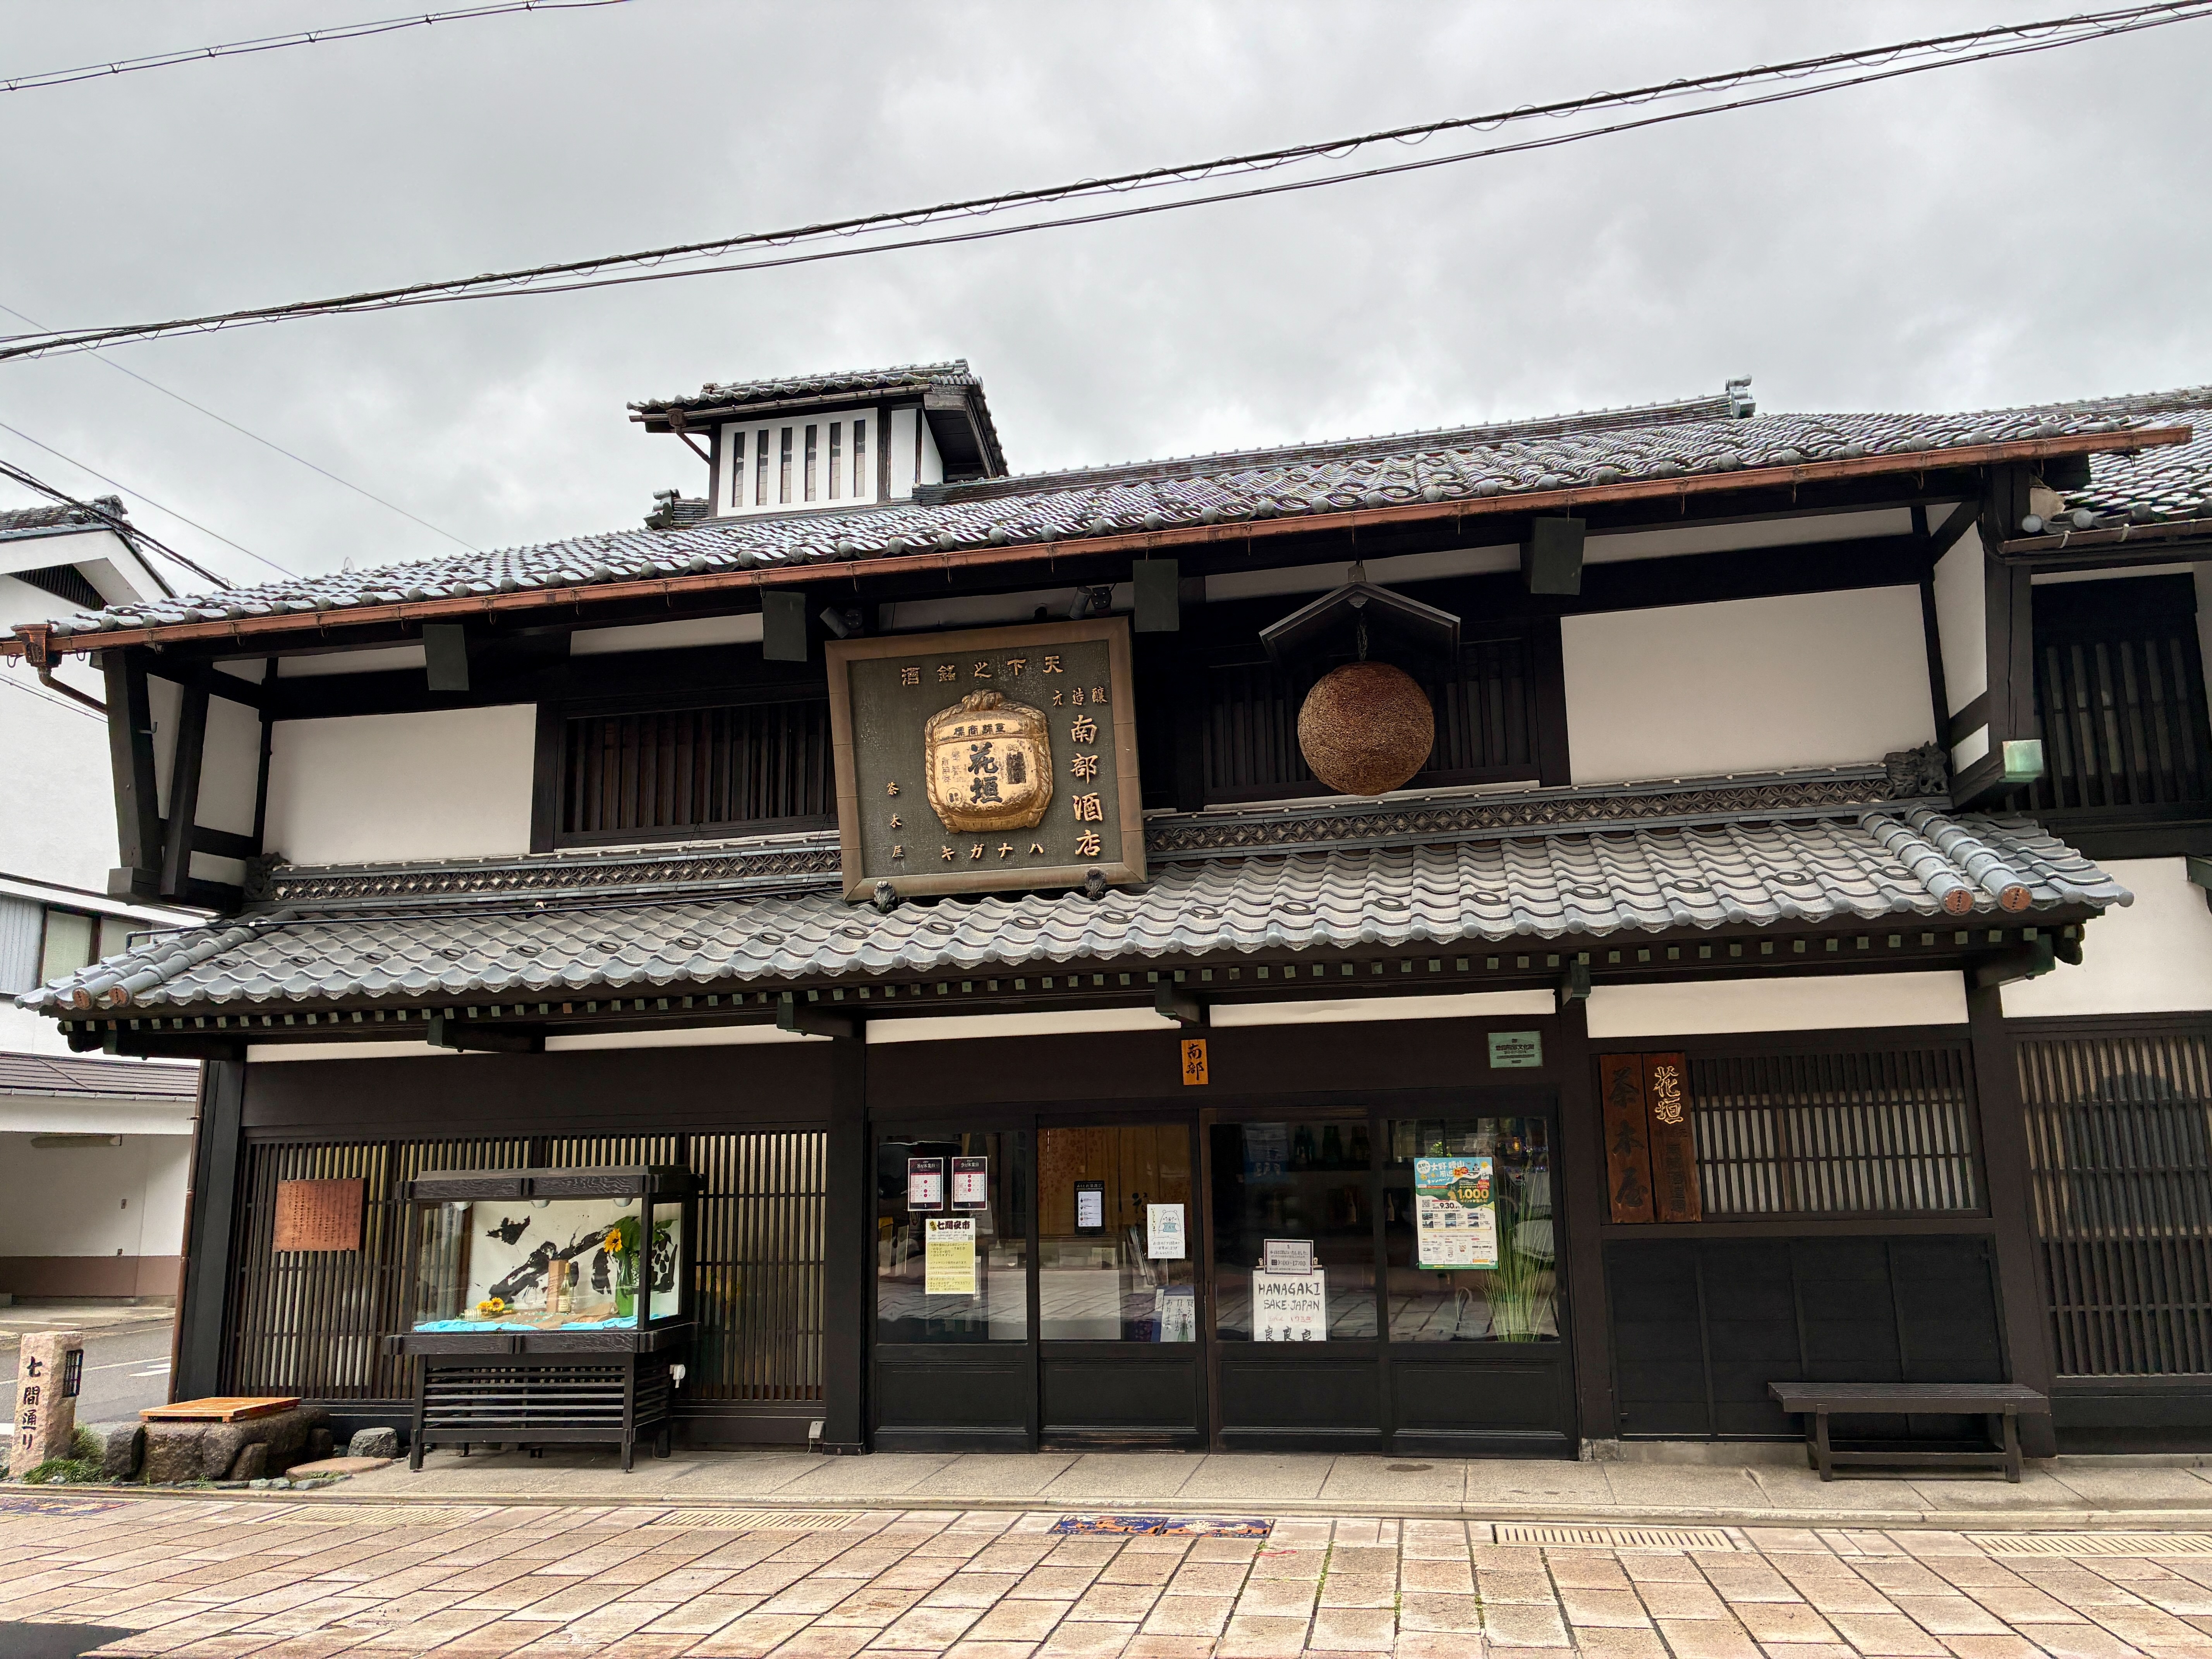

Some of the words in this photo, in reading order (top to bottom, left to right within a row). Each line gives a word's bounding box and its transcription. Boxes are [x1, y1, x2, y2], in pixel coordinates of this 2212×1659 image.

[968, 742, 1003, 804] 花垣
[1070, 714, 1103, 857] 南部酒店
[941, 842, 1044, 860] ハナガキ
[1186, 1043, 1204, 1080] 南部
[1653, 1066, 1684, 1124] 花垣
[1457, 1188, 1489, 1199] 1,000
[937, 1220, 970, 1230] 七間夜市
[1259, 1282, 1321, 1296] HANAGAKI
[22, 1356, 43, 1450] 七間通り
